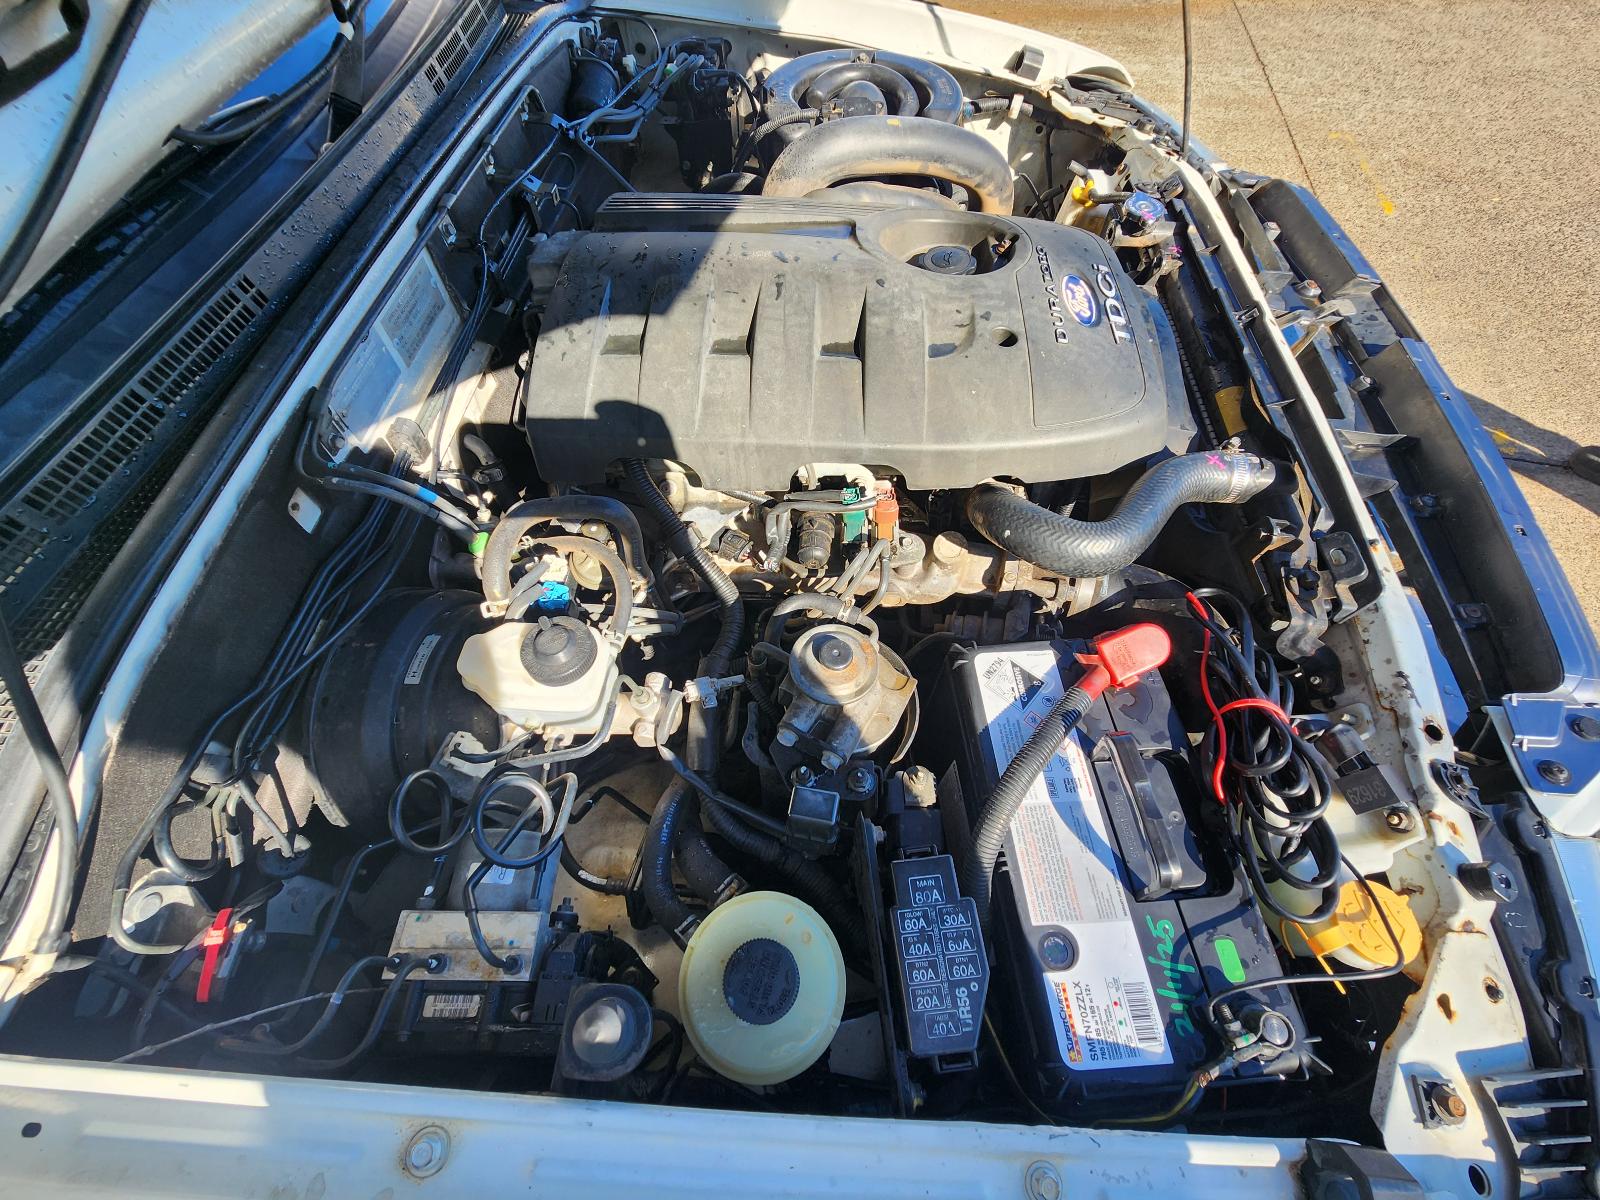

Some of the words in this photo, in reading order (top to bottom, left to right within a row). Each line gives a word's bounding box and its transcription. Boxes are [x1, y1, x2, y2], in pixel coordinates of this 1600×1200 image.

[1036, 245, 1069, 344] DURATORQ
[1092, 264, 1131, 344] TDCi
[916, 879, 935, 888] MAIN
[915, 889, 942, 904] 80A
[904, 917, 927, 930] 60A
[943, 913, 966, 927] 30A
[908, 941, 932, 955] 40A
[948, 938, 971, 951] 60A
[913, 967, 936, 982] 60A
[953, 963, 976, 978] 60A
[916, 995, 940, 1009] 20A
[956, 986, 973, 1032] UR56
[932, 1021, 957, 1036] 40A
[1073, 981, 1099, 1061] SMFN70ZZLX
